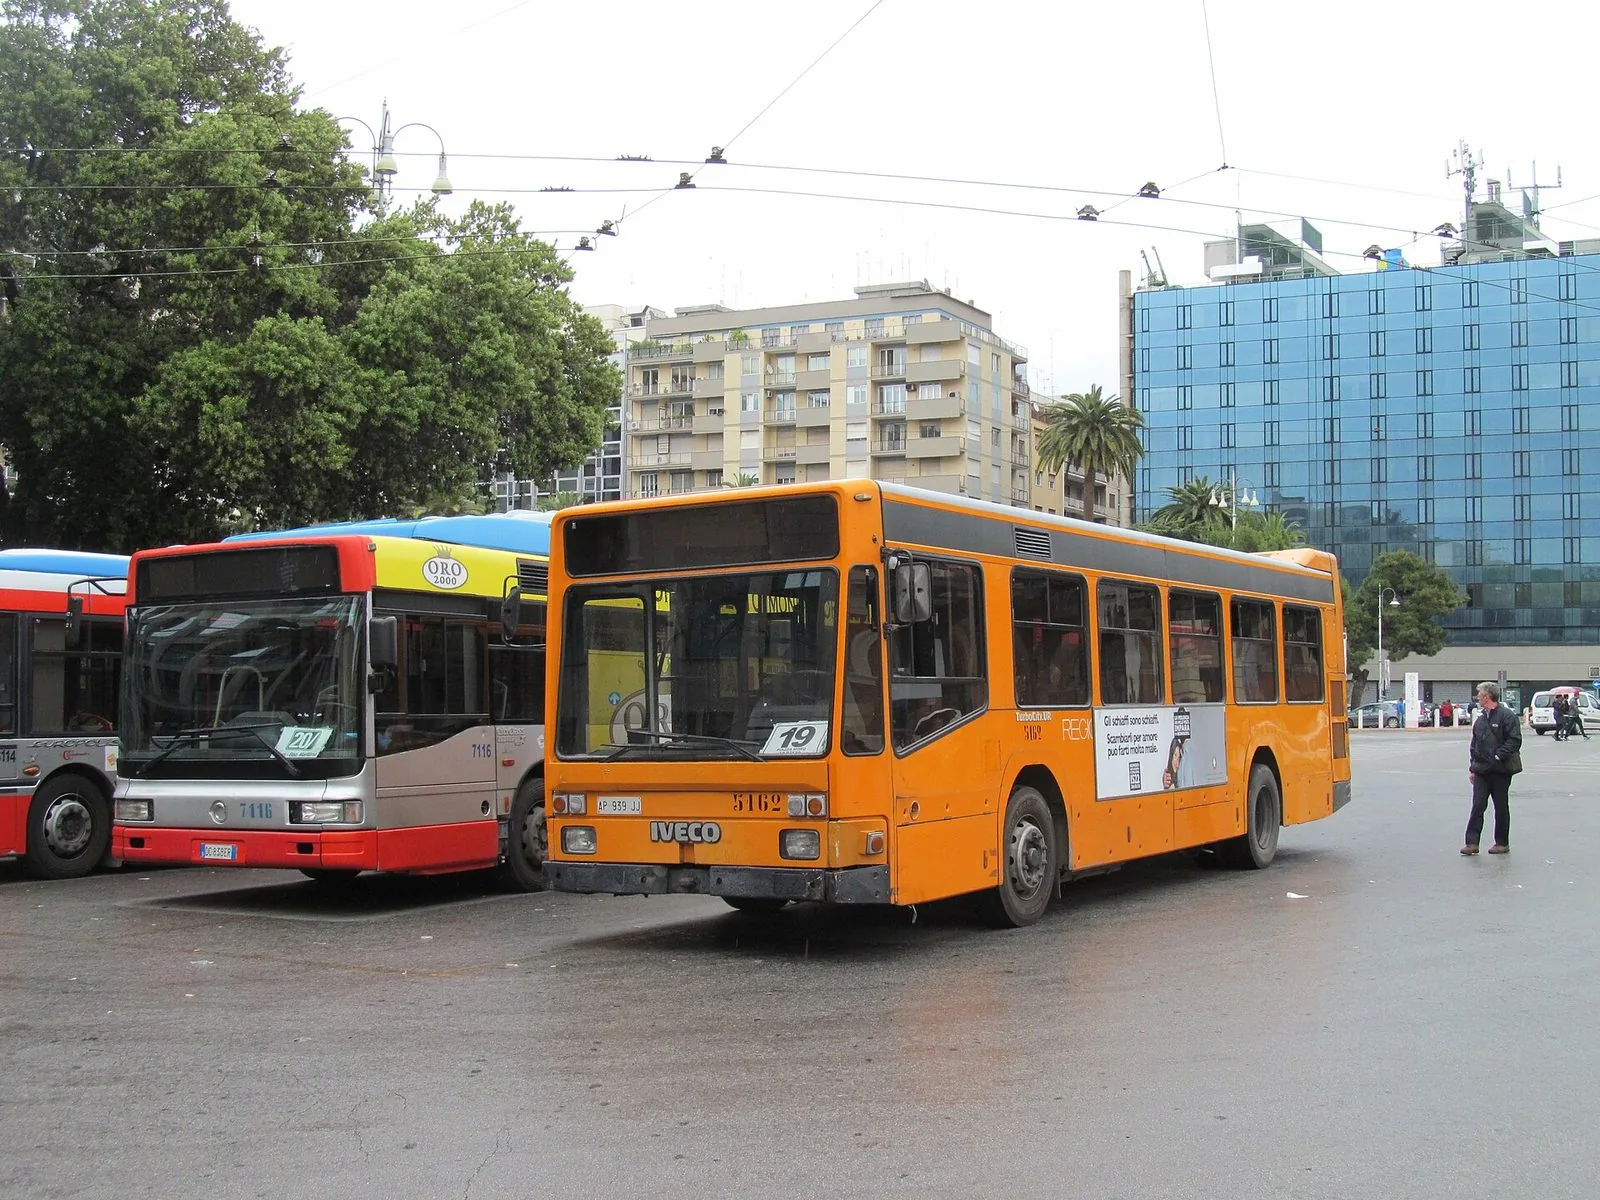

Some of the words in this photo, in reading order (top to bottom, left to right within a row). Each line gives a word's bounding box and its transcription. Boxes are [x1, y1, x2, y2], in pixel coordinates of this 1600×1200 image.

[428, 560, 462, 577] ORO
[434, 575, 457, 586] 2000
[1112, 714, 1130, 726] schiaffi
[1130, 717, 1141, 726] sono
[1142, 713, 1160, 725] schiaffi.
[779, 725, 817, 748] 19
[1023, 725, 1042, 741] 5162
[1133, 734, 1142, 746] per
[1142, 733, 1158, 742] amore
[472, 743, 492, 758] 7116
[1107, 745, 1118, 760] può
[1118, 745, 1130, 756] farti
[598, 801, 608, 812] AP
[612, 801, 627, 812] 939
[630, 801, 641, 812] JJ
[733, 794, 781, 812] 5162
[240, 803, 273, 819] 7116
[650, 821, 722, 843] IVECO
